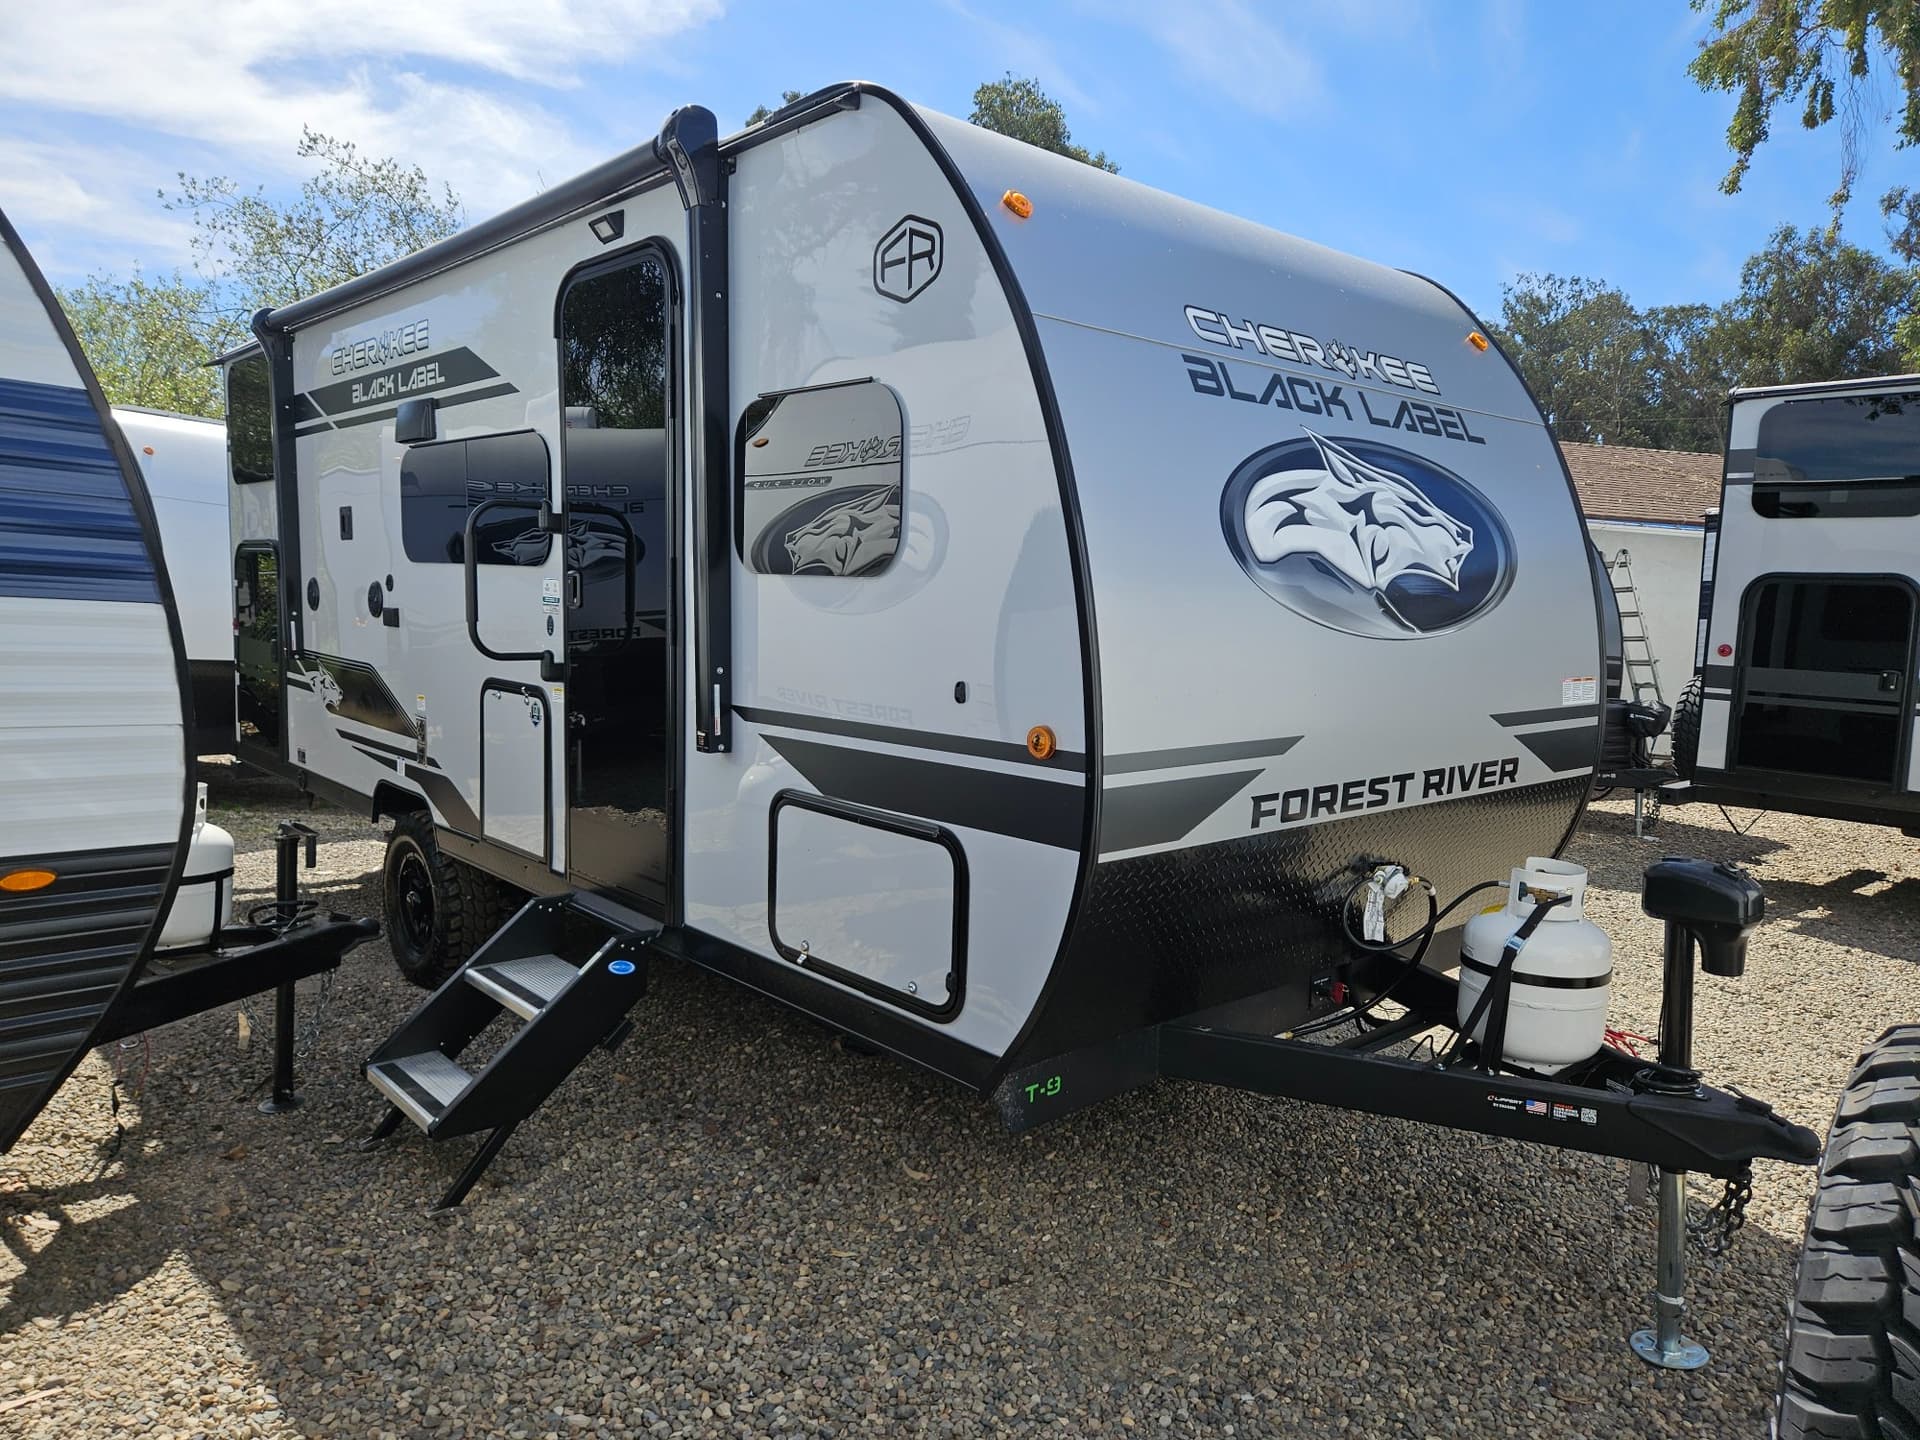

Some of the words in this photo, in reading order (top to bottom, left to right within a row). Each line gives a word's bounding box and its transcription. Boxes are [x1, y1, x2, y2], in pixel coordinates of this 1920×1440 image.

[331, 319, 429, 375] CHEROKEE
[352, 374, 394, 404] BLACK
[398, 361, 445, 392] LABEL
[1183, 304, 1441, 396] CHEROKEE
[1181, 353, 1354, 421] BLACK
[1358, 391, 1487, 445] LABEL
[1250, 771, 1416, 830] FOREST
[1422, 756, 1520, 799] RIVER
